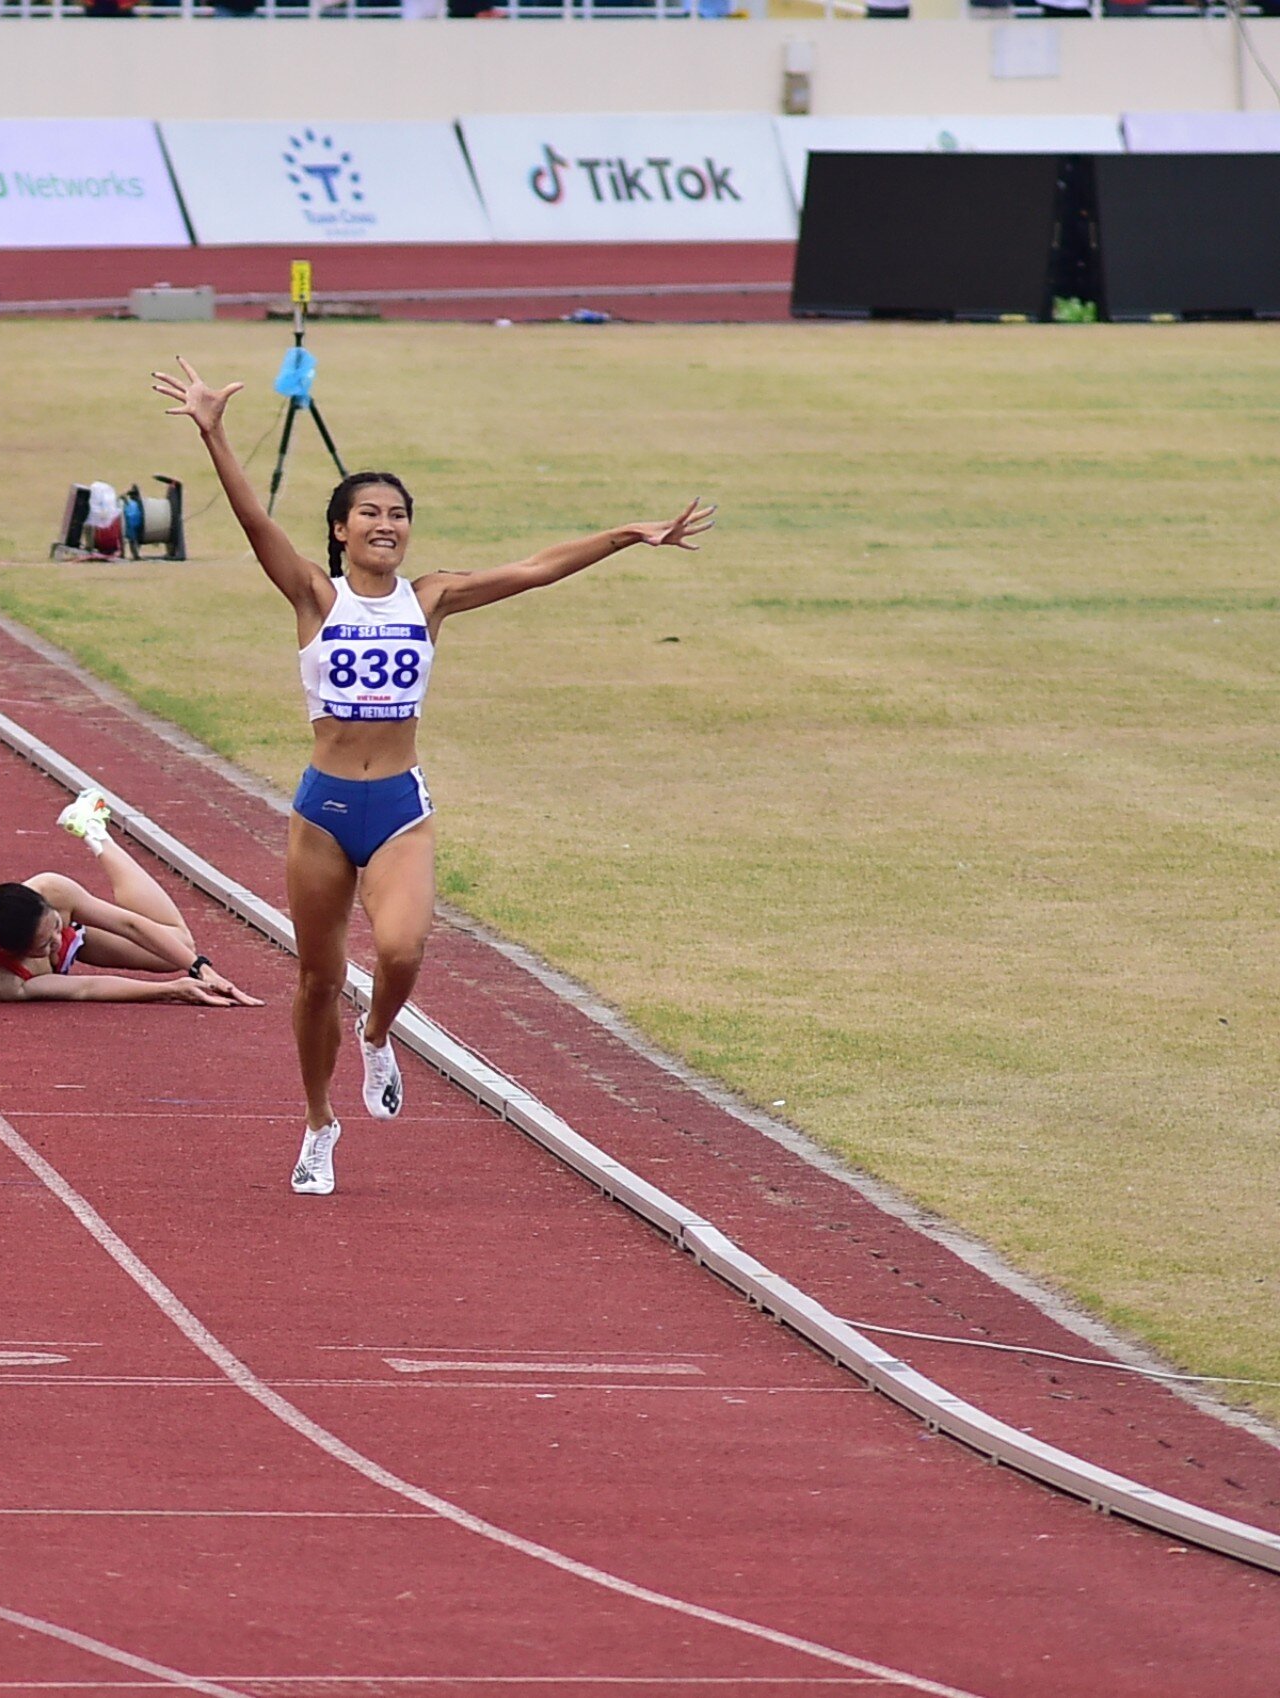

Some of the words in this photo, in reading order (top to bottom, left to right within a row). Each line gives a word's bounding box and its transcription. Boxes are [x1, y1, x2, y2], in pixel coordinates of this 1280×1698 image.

[14, 171, 145, 198] Networks
[576, 158, 742, 202] TikTok
[358, 626, 378, 638] SEA
[329, 648, 420, 689] 838
[359, 705, 398, 718] VIETNAM
